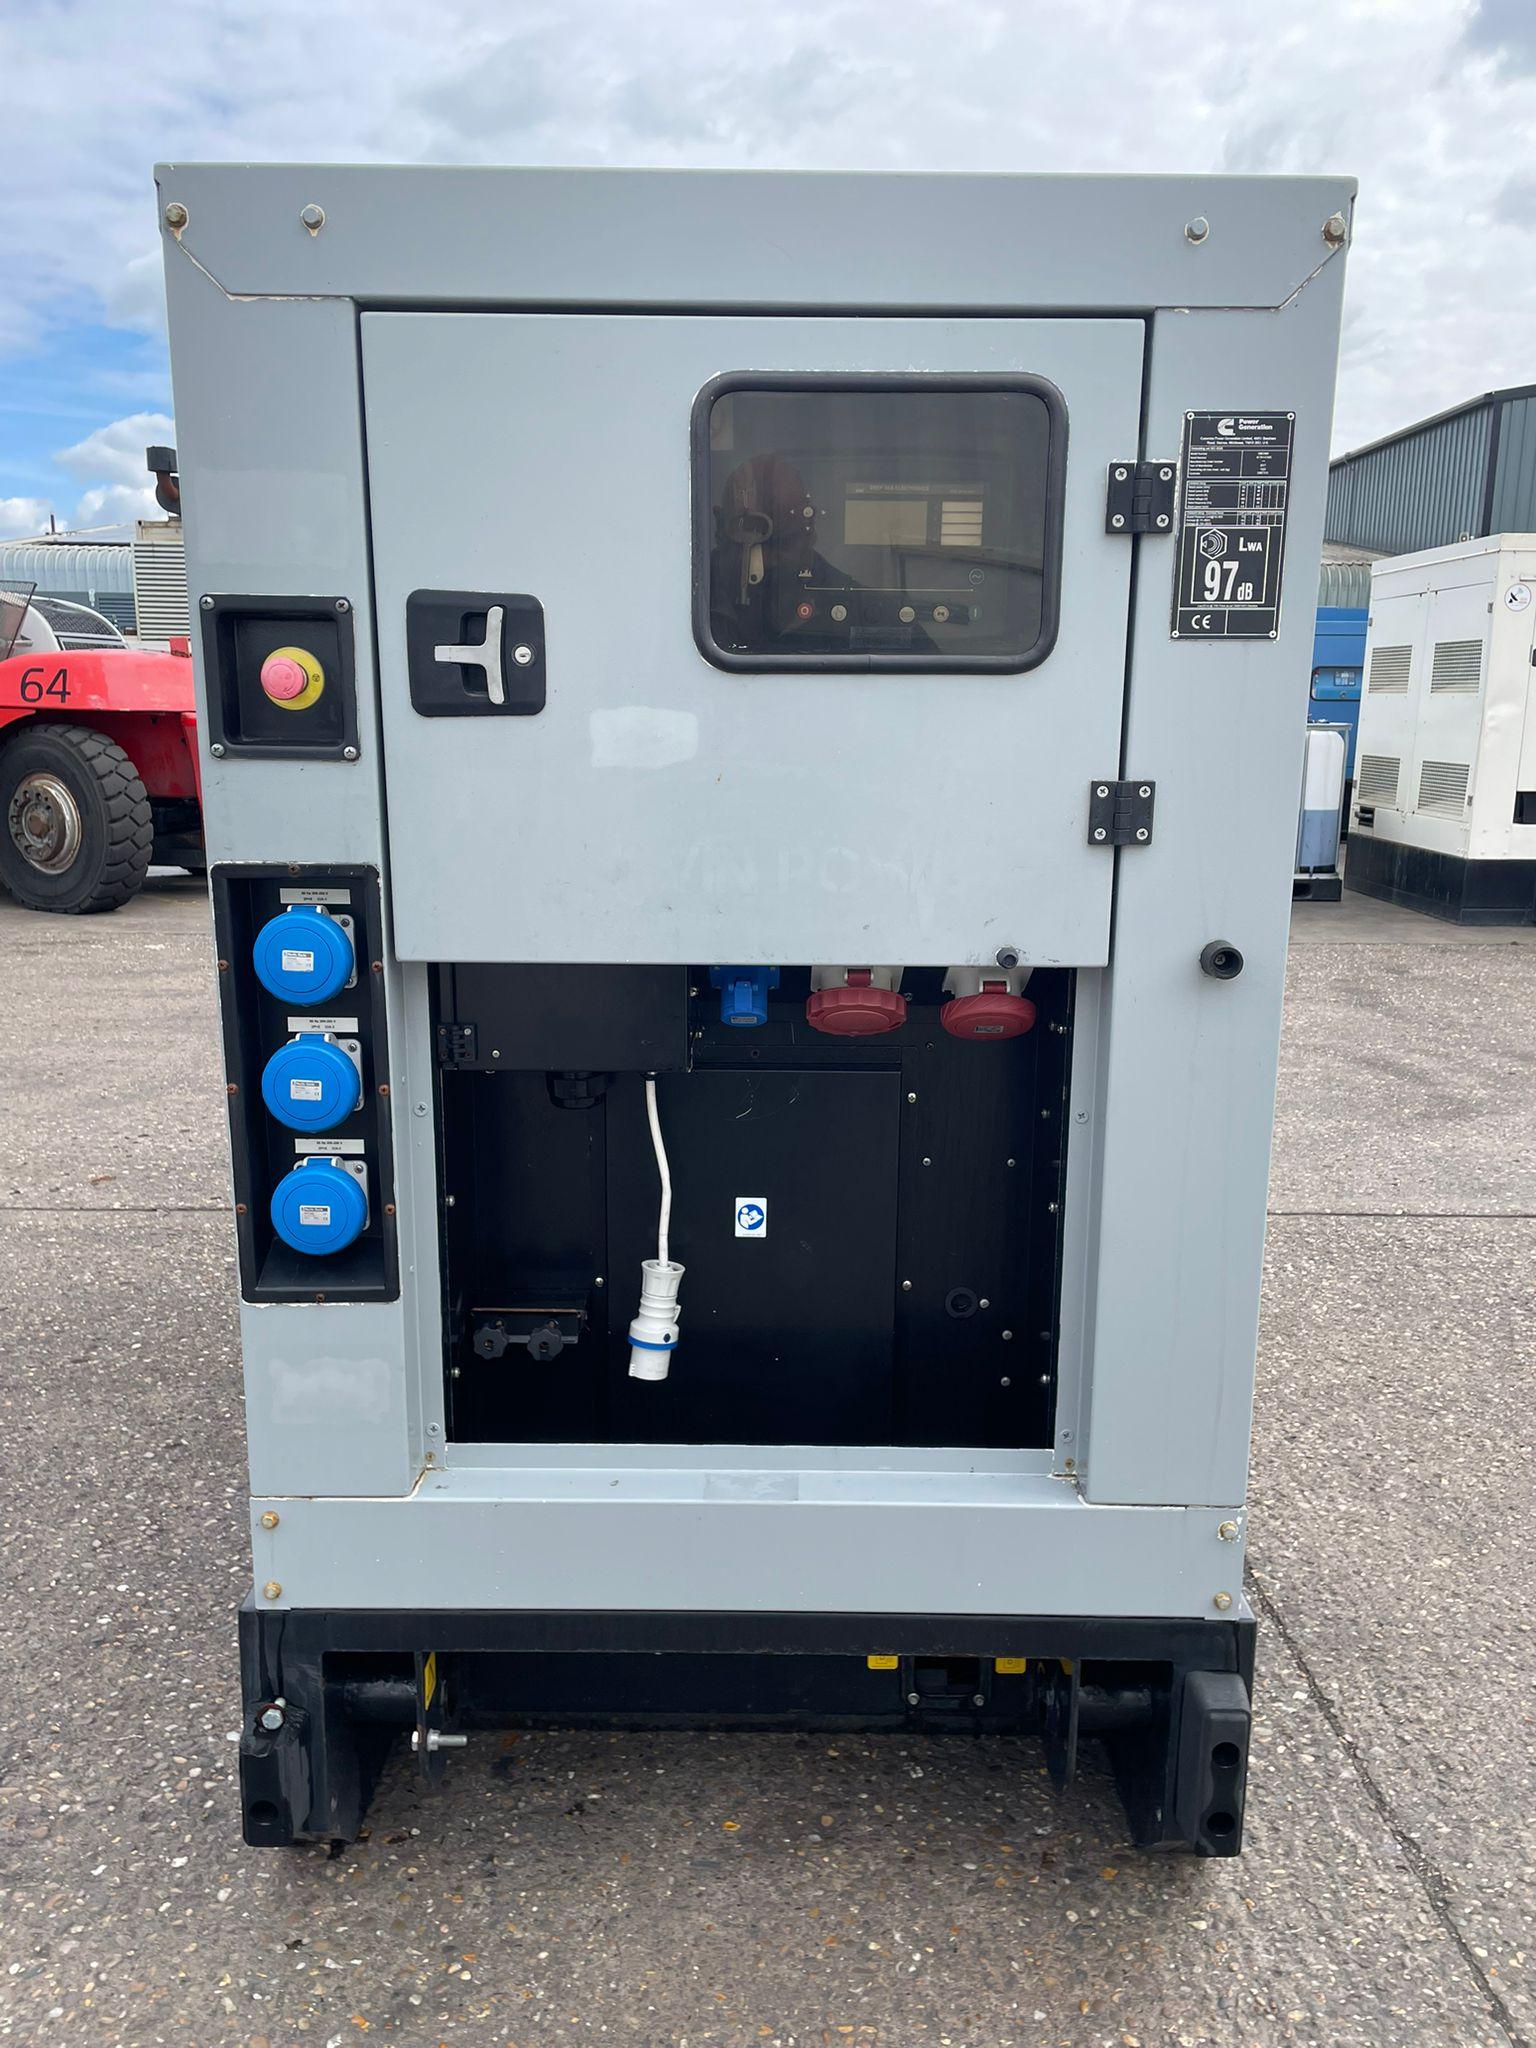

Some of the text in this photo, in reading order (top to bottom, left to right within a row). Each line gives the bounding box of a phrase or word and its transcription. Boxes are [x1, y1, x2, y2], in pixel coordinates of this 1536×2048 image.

[1203, 560, 1253, 602] 97 dB
[20, 667, 72, 704] 64
